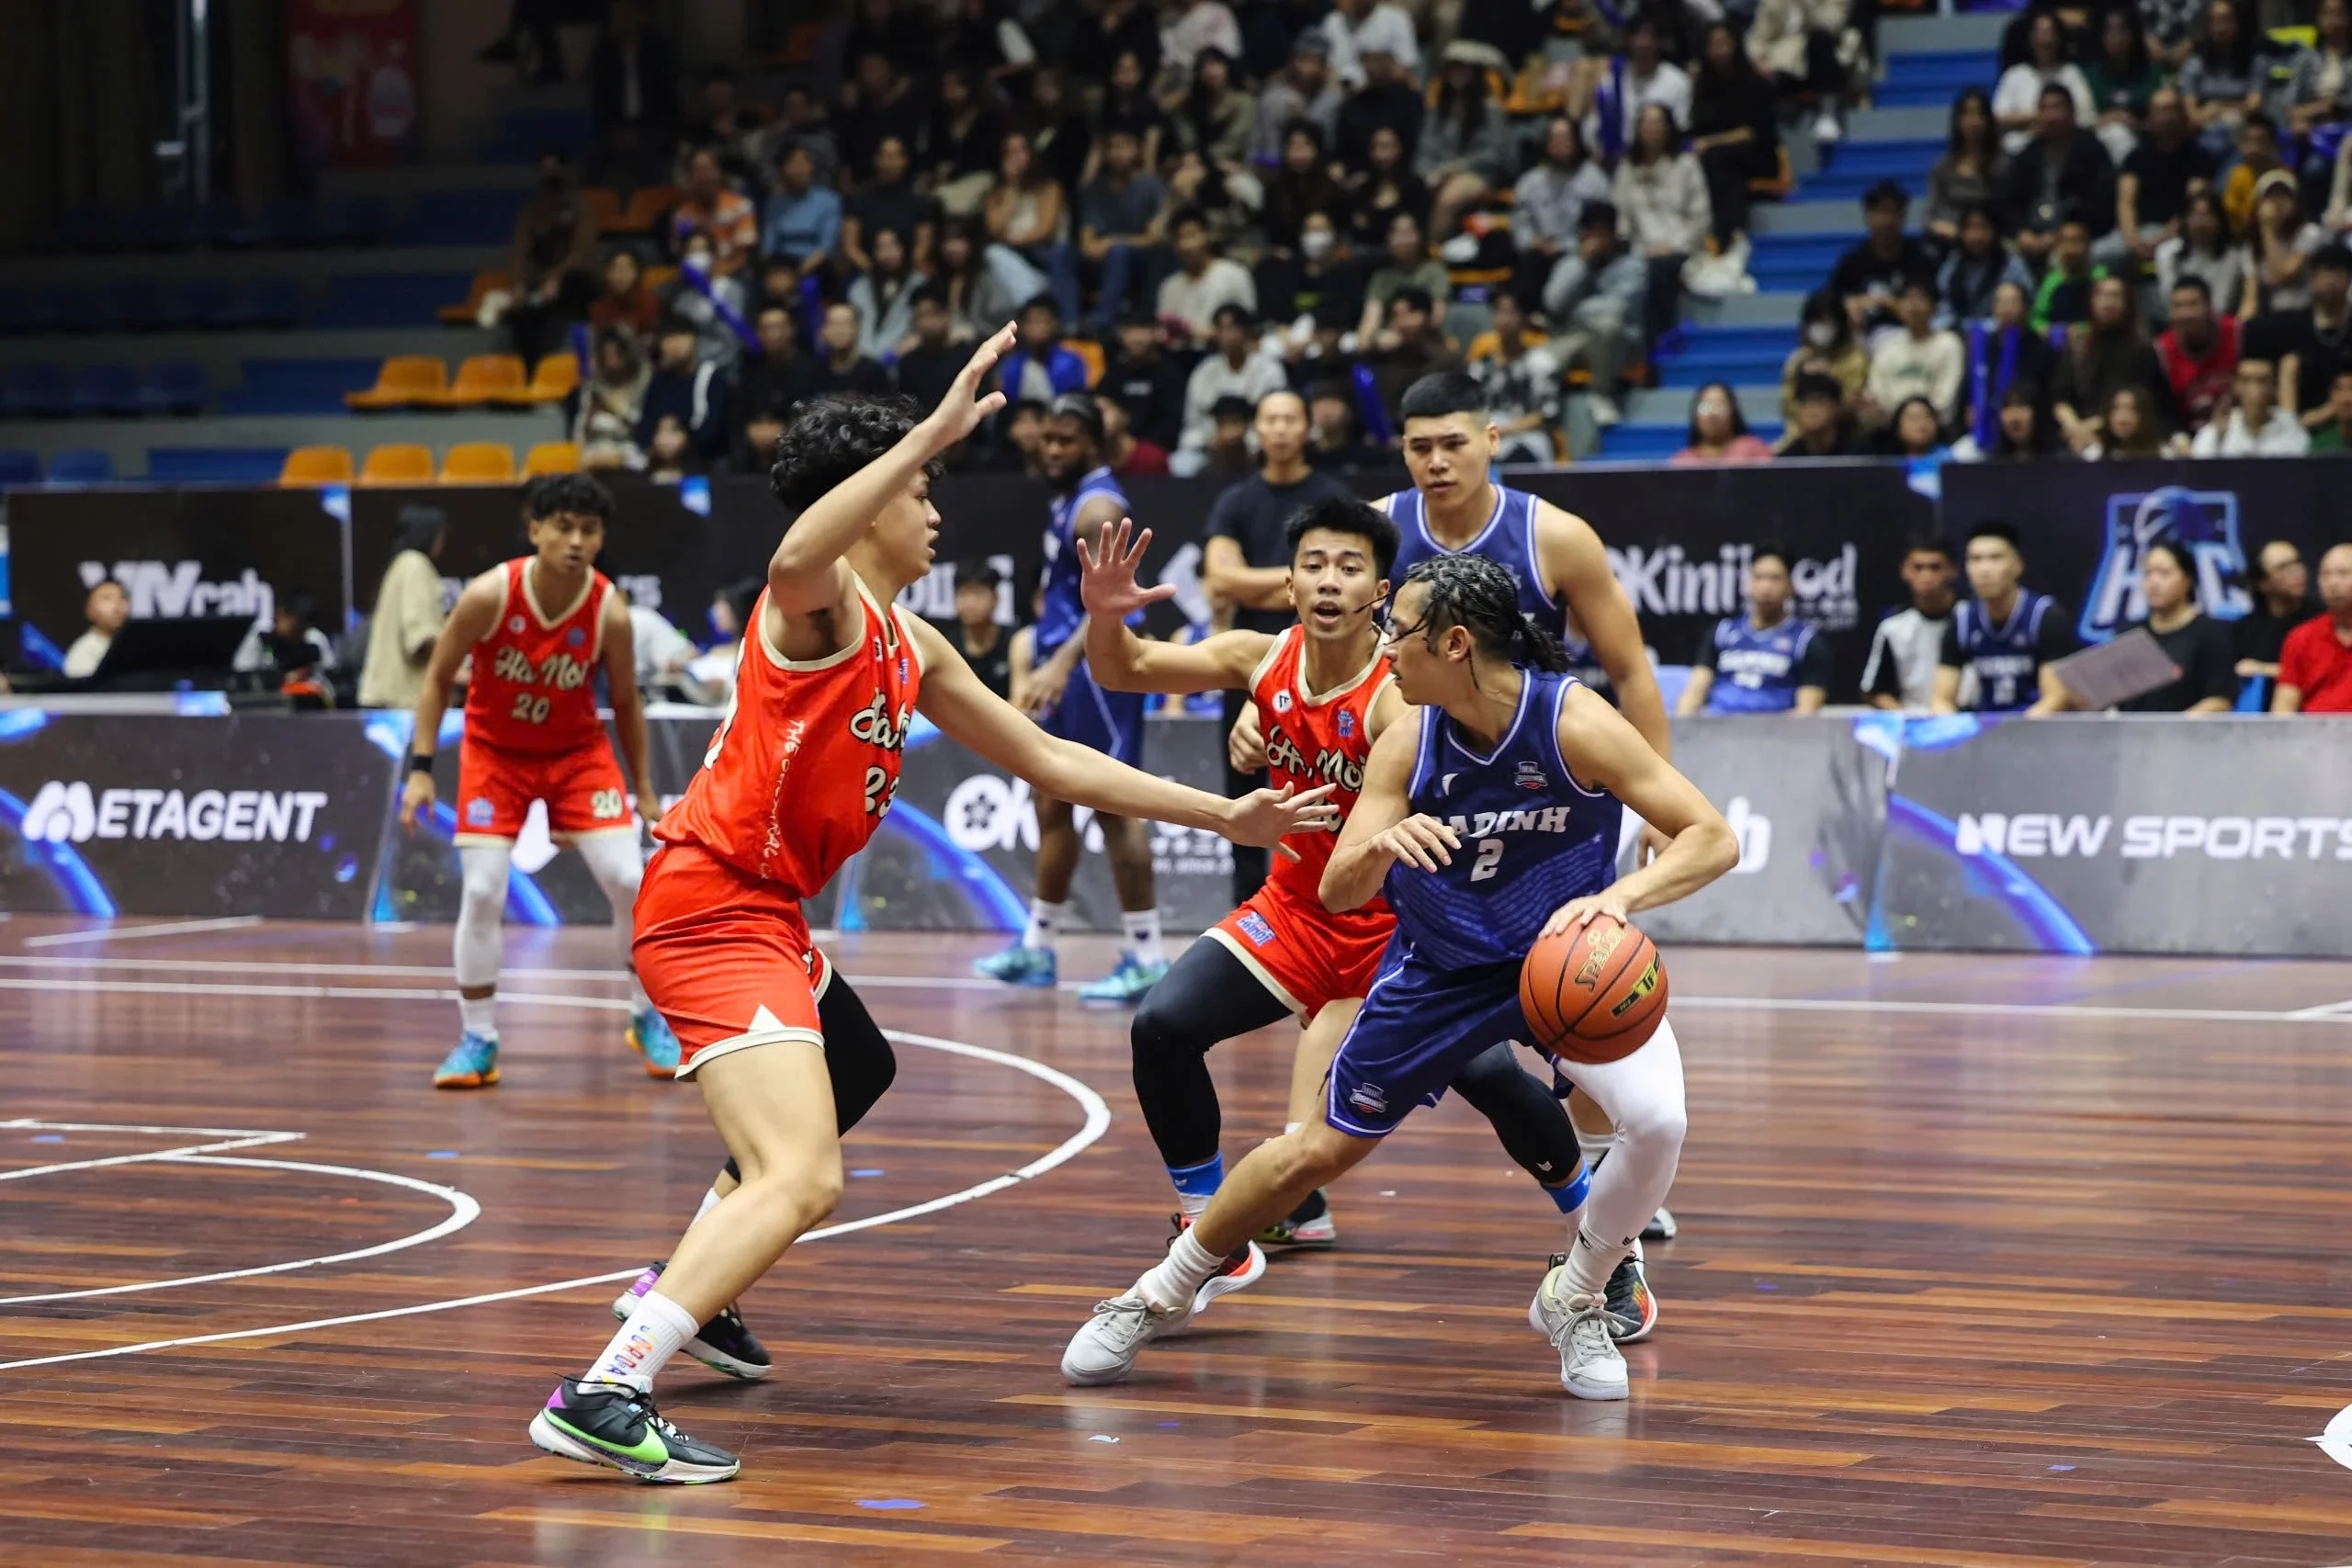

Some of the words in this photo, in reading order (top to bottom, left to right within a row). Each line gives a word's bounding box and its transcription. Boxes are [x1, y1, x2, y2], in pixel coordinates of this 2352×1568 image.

[511, 693, 551, 725] 20
[590, 787, 625, 819] 20
[1955, 811, 2112, 857] NEW
[1470, 838, 1504, 883] 2
